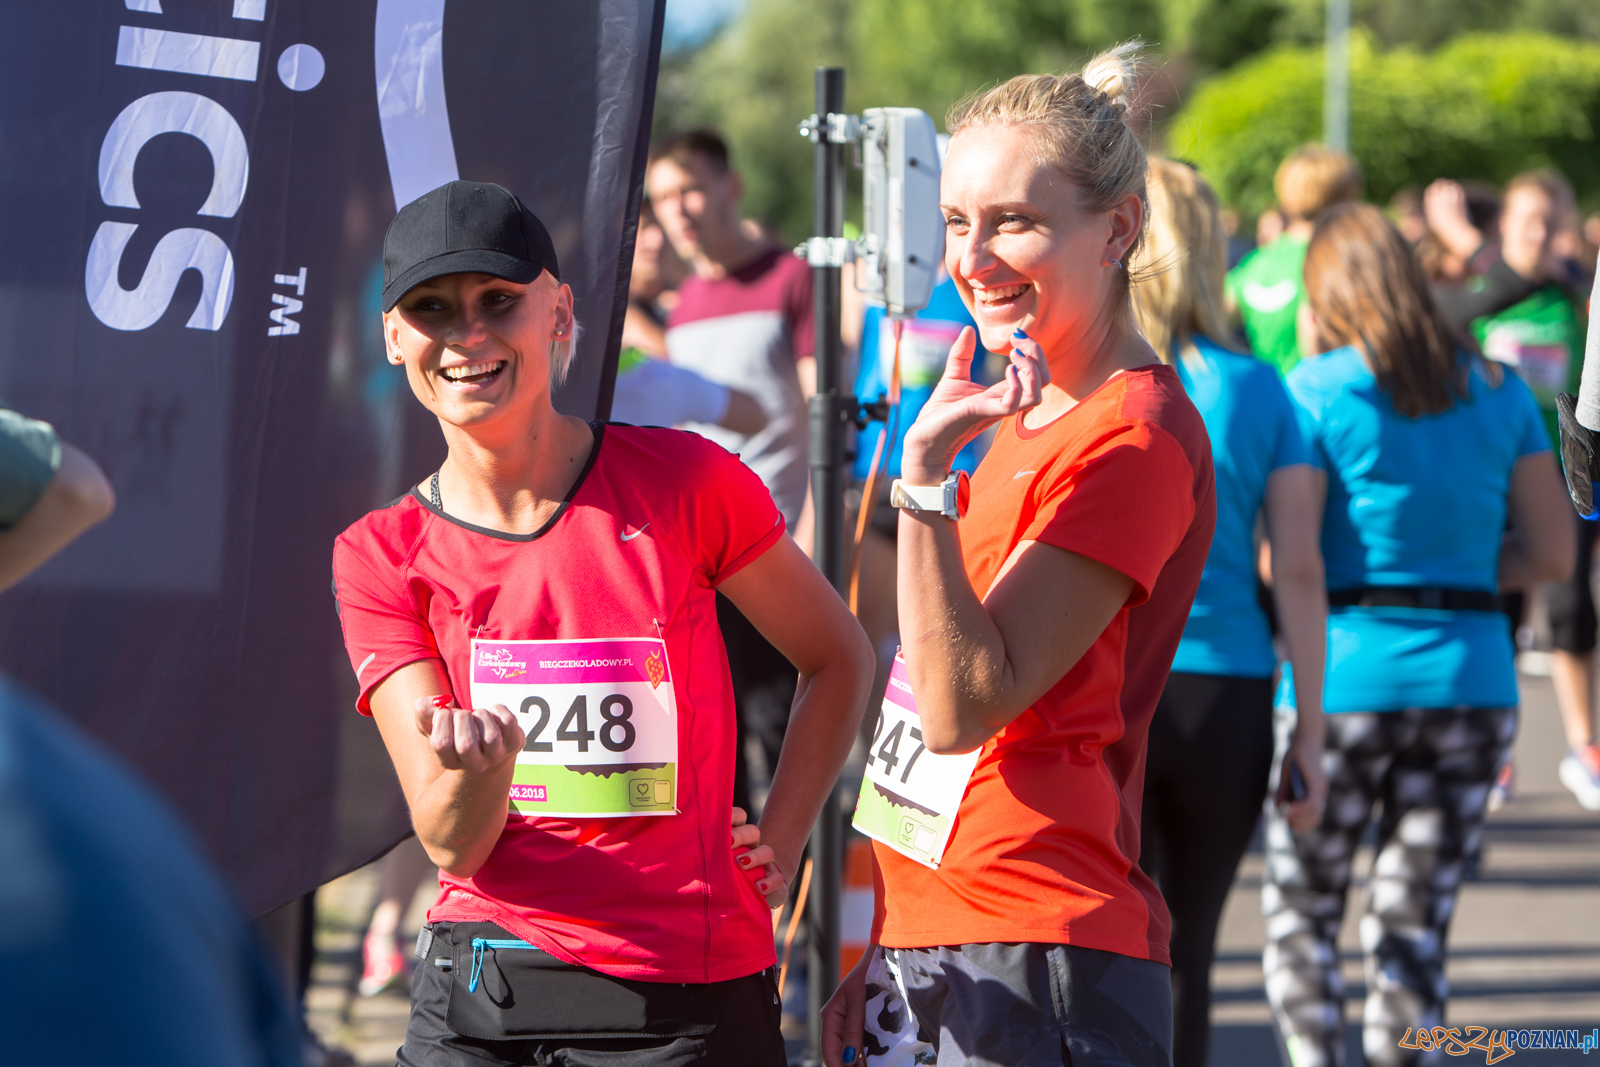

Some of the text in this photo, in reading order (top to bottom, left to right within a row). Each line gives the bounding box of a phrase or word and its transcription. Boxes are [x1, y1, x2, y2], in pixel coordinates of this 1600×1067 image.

[85, 0, 325, 331] ics
[267, 266, 307, 336] TM
[539, 659, 633, 668] BIEGCZEKOLADOWY.PL
[519, 693, 636, 752] 248
[509, 786, 545, 798] 06.2018
